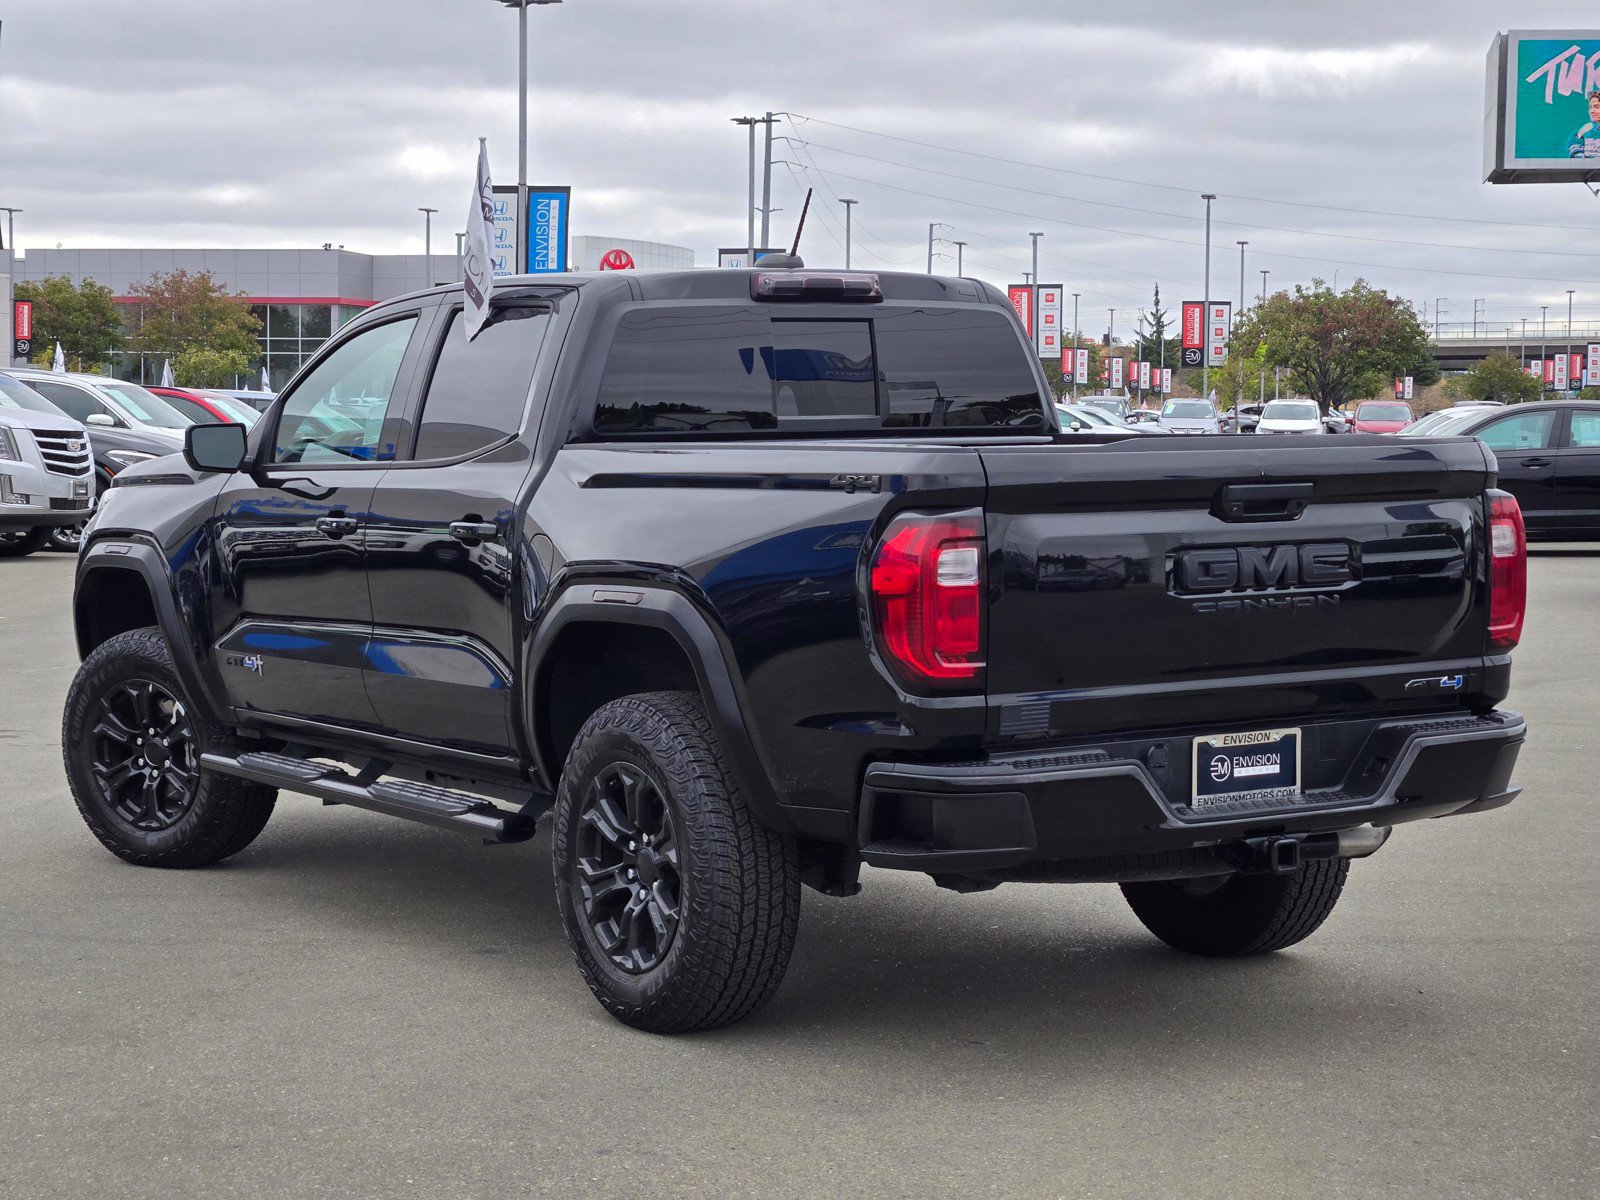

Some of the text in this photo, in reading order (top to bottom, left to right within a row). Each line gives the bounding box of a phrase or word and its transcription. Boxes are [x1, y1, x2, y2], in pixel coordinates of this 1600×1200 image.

[535, 199, 550, 270] ENVISION
[550, 205, 558, 264] MOTORS
[1186, 307, 1195, 345] ENVISION
[1178, 543, 1350, 590] GMC
[1223, 732, 1271, 745] ENVISION
[1233, 753, 1280, 768] ENVISION
